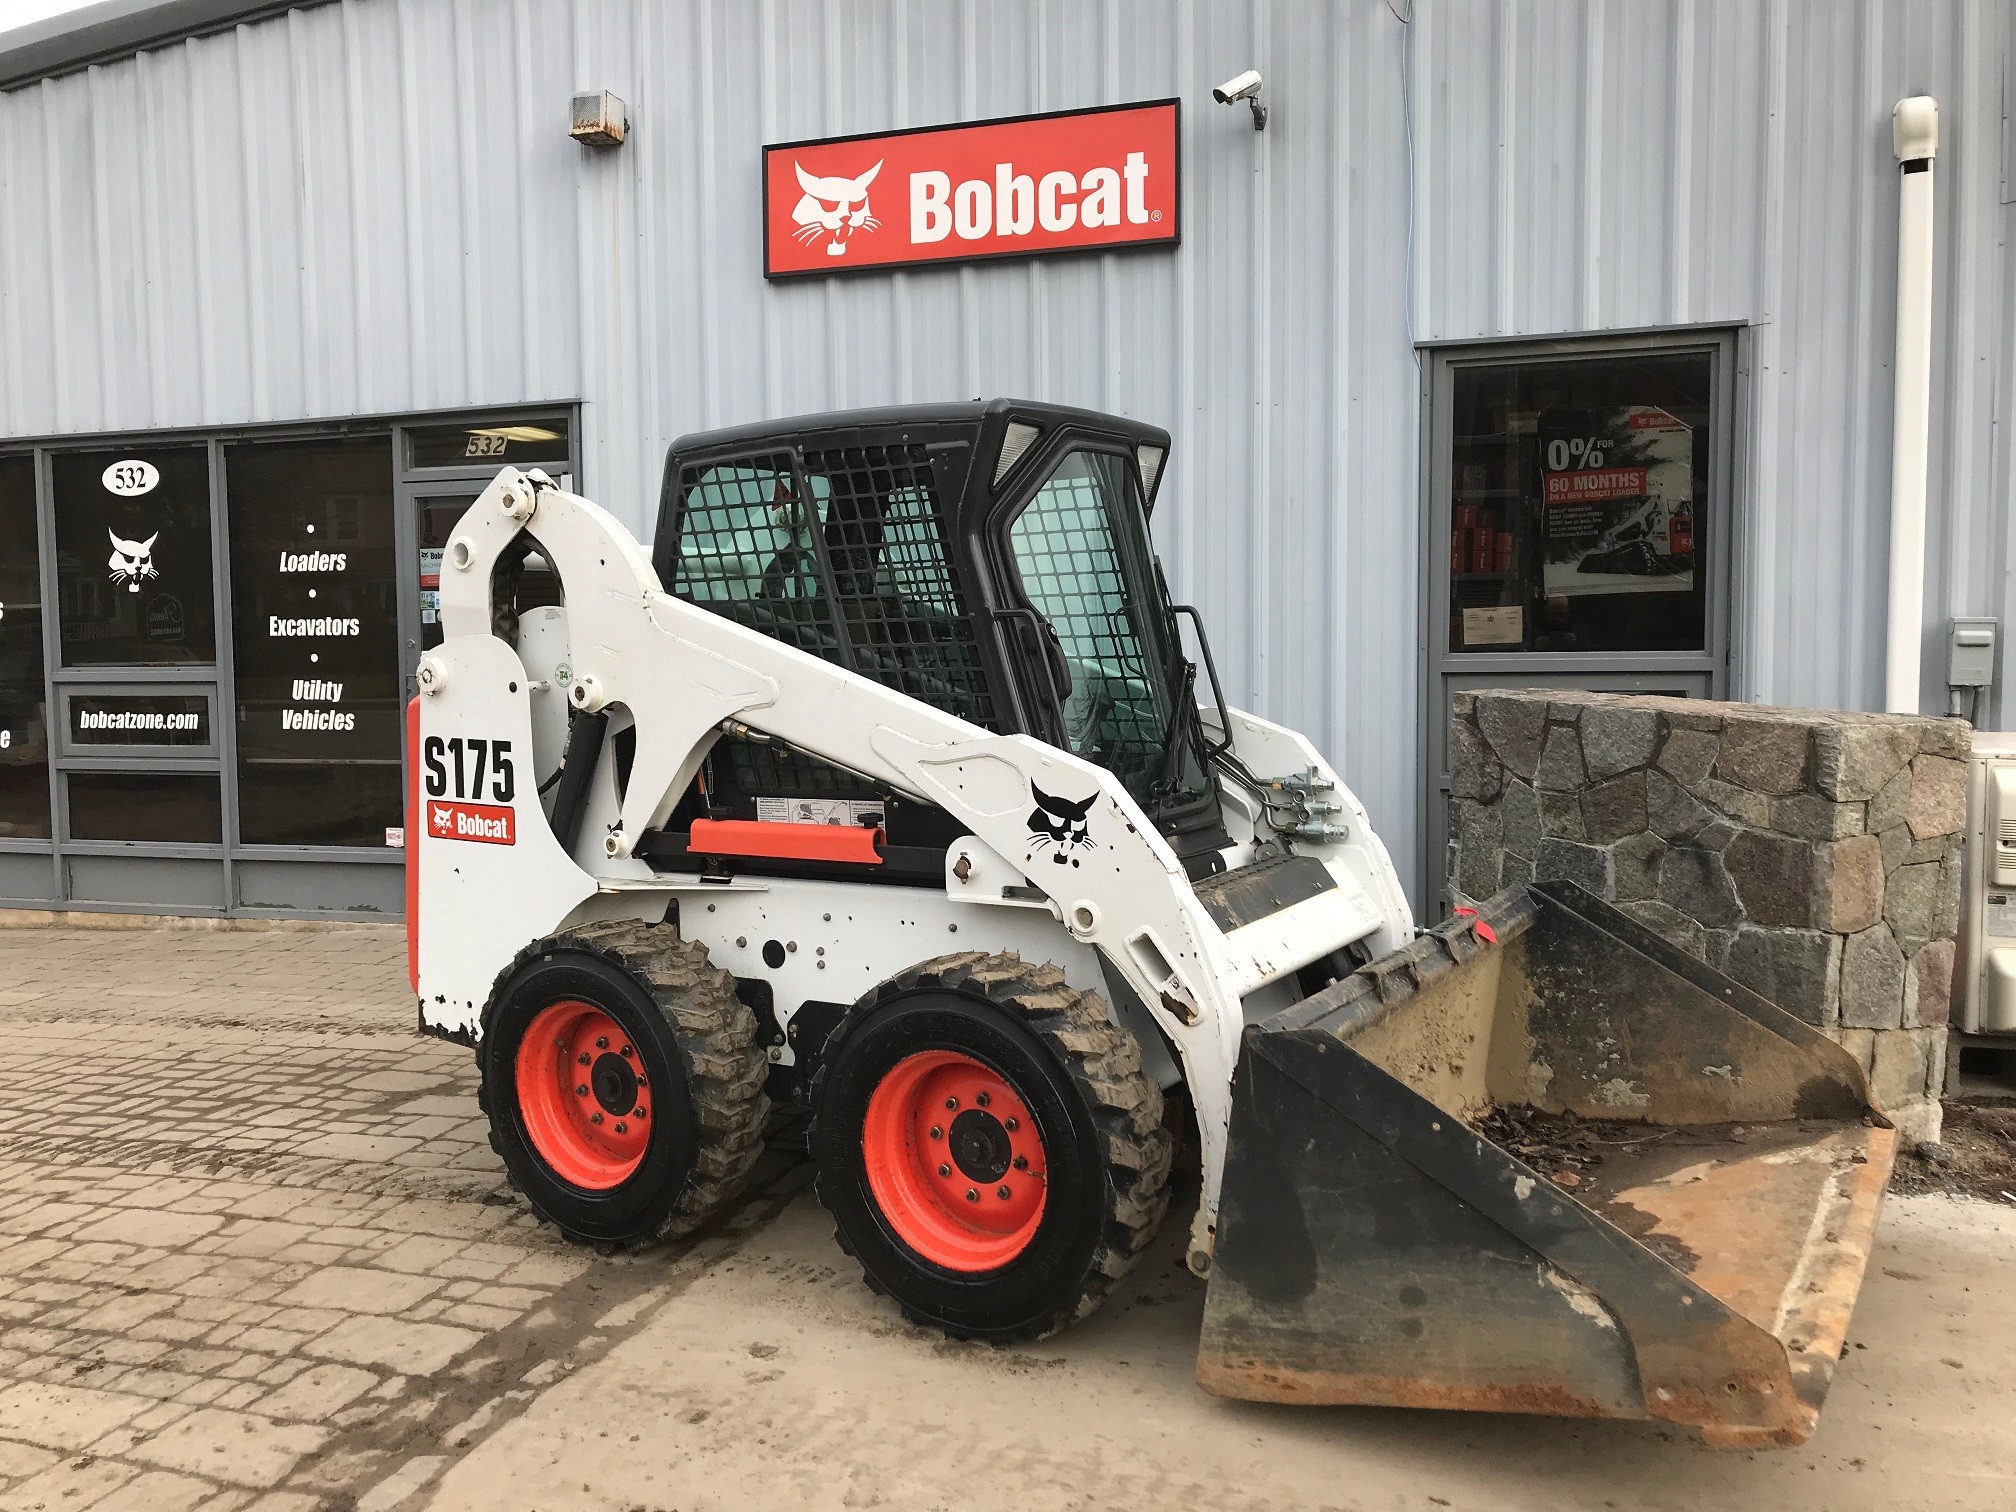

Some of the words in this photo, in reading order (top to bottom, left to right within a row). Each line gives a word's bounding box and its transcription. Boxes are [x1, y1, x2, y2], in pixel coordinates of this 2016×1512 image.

[468, 436, 505, 455] 532
[1547, 436, 1604, 471] 0%
[1597, 439, 1614, 449] FOR
[115, 466, 147, 490] 532
[1549, 477, 1569, 493] 60
[1549, 493, 1560, 501] ON
[1568, 491, 1583, 500] NEW
[1584, 489, 1611, 499] BOBCAT
[279, 551, 347, 573] Loaders
[269, 615, 360, 637] Excavators
[292, 679, 343, 703] Utility
[80, 710, 199, 730] bobcatzone.com
[282, 709, 355, 731] Vehicles
[424, 735, 515, 803] S175
